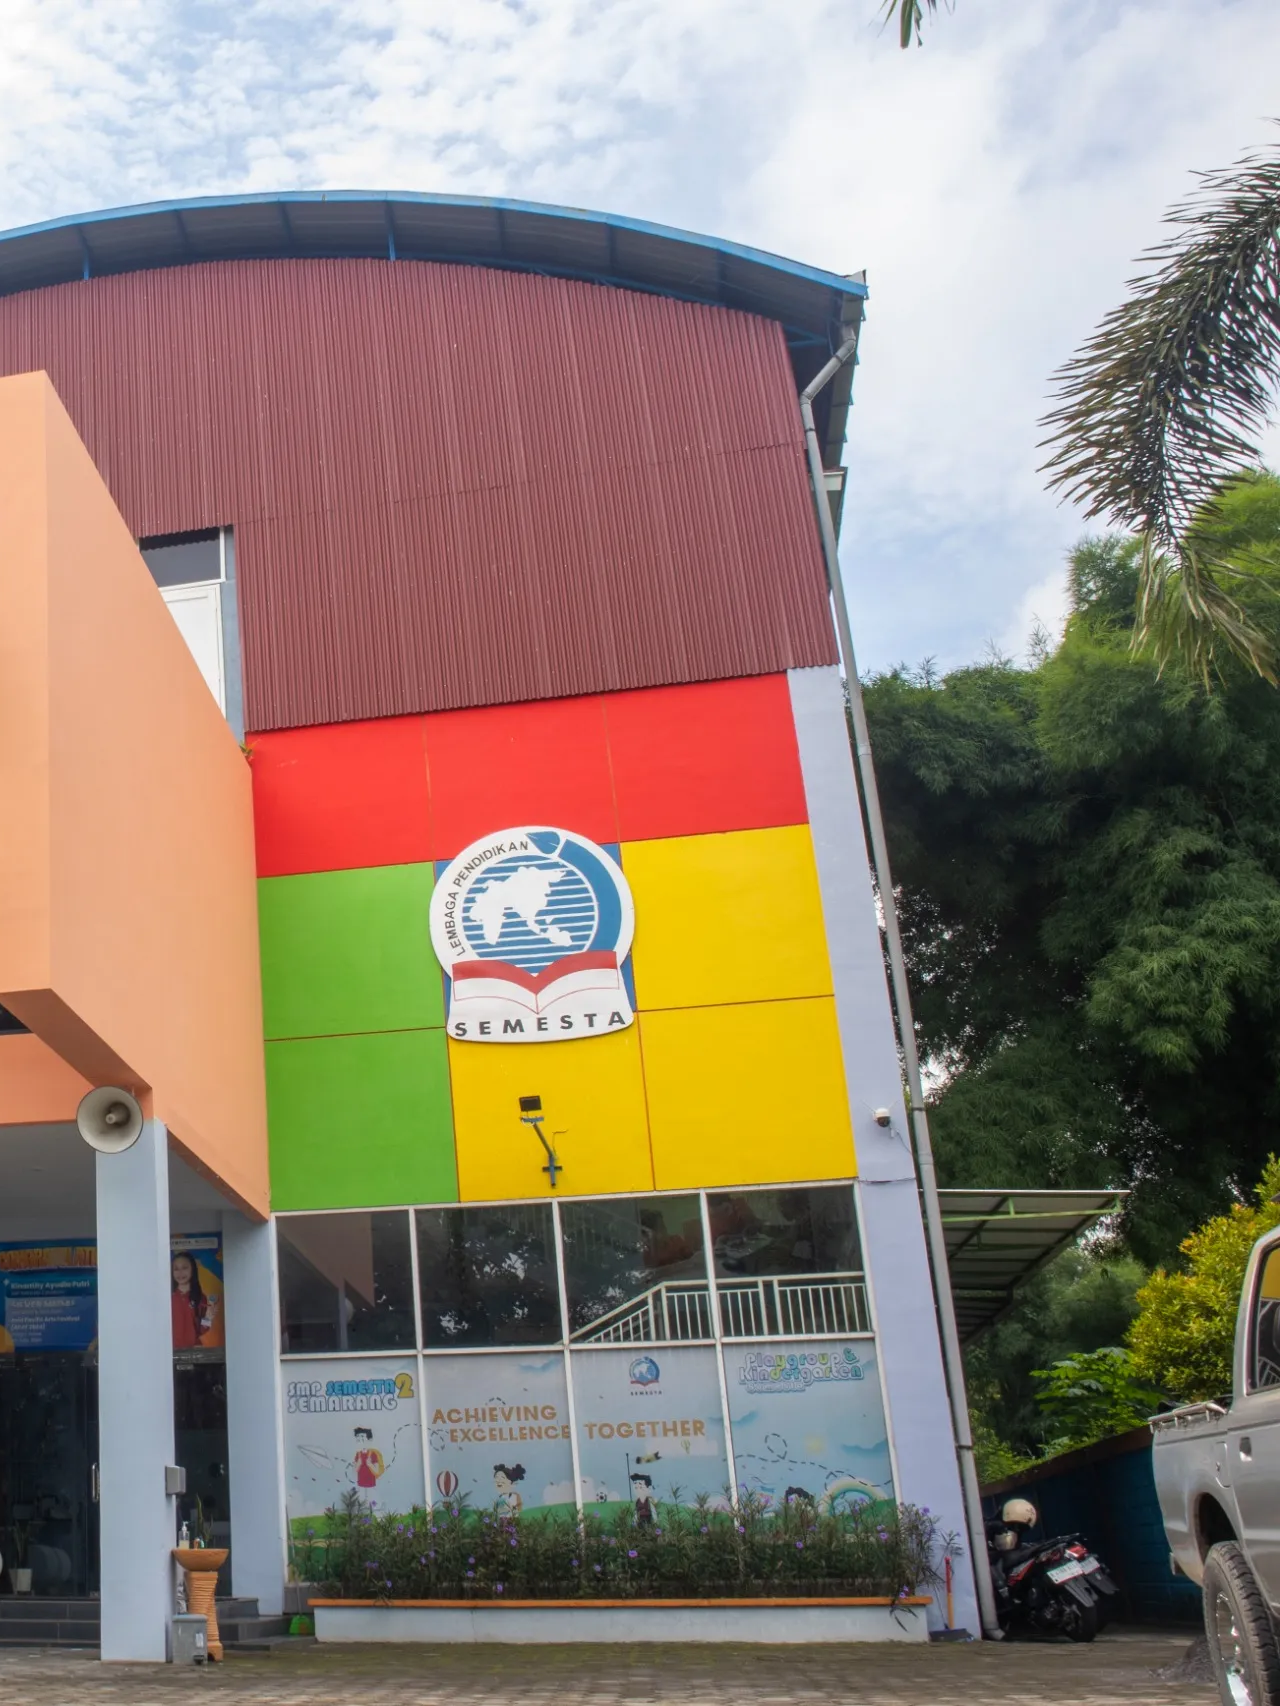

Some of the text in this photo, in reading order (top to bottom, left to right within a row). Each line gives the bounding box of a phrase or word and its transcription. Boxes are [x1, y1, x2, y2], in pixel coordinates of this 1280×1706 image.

[444, 841, 529, 957] LEMBAGA PENDIDIKAN
[454, 1010, 626, 1038] SEMESTA
[745, 1352, 841, 1369] Playgroup
[739, 1365, 862, 1384] Kindergarten
[287, 1381, 322, 1397] SMP
[325, 1379, 395, 1396] SEMESTA
[287, 1393, 398, 1413] SEMARANG
[431, 1405, 557, 1425] ACHIEVING
[449, 1420, 706, 1443] EXCELLENCE TOGETHER
